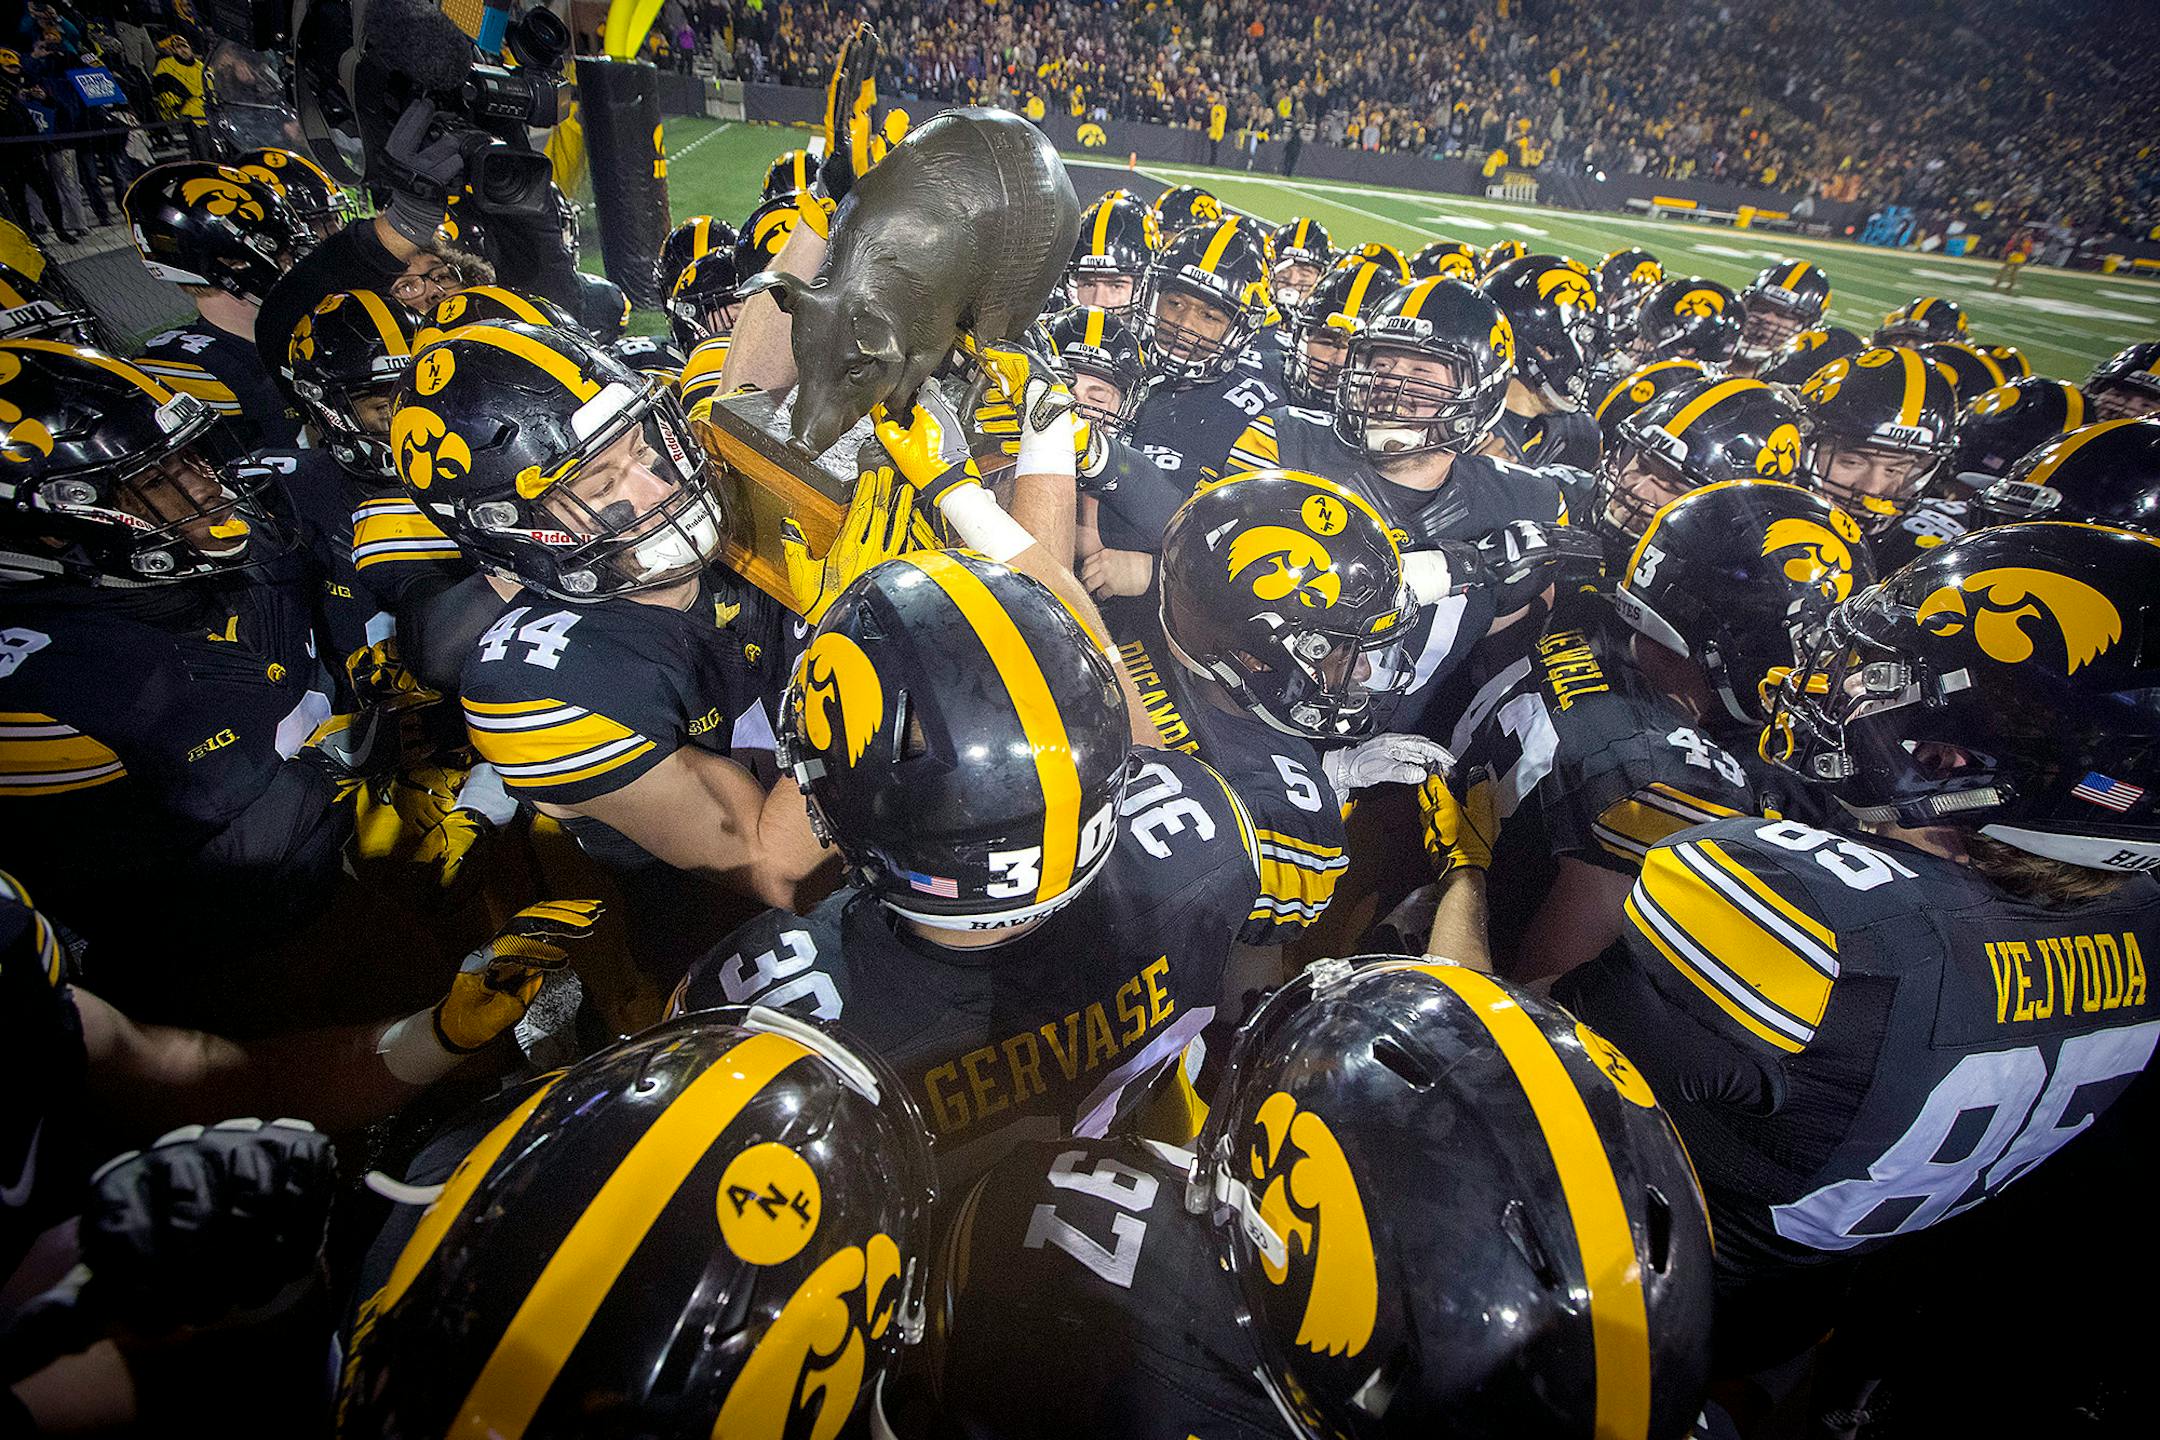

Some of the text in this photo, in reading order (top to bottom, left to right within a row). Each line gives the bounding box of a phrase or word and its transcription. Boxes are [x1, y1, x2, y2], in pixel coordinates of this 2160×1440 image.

[1086, 256, 1107, 267] IOWA
[1190, 267, 1215, 286] IOWA
[6, 302, 52, 326] IOWA
[1386, 317, 1416, 332] IOWA
[1078, 343, 1100, 355] IOWA
[1221, 377, 1280, 417] 57
[1887, 426, 1923, 446] IOWA
[1633, 543, 1667, 589] 3
[478, 606, 584, 670] 44
[1270, 754, 1323, 813] 5
[1984, 932, 2147, 1024] VEJVODA
[924, 954, 1175, 1134] GERVASE
